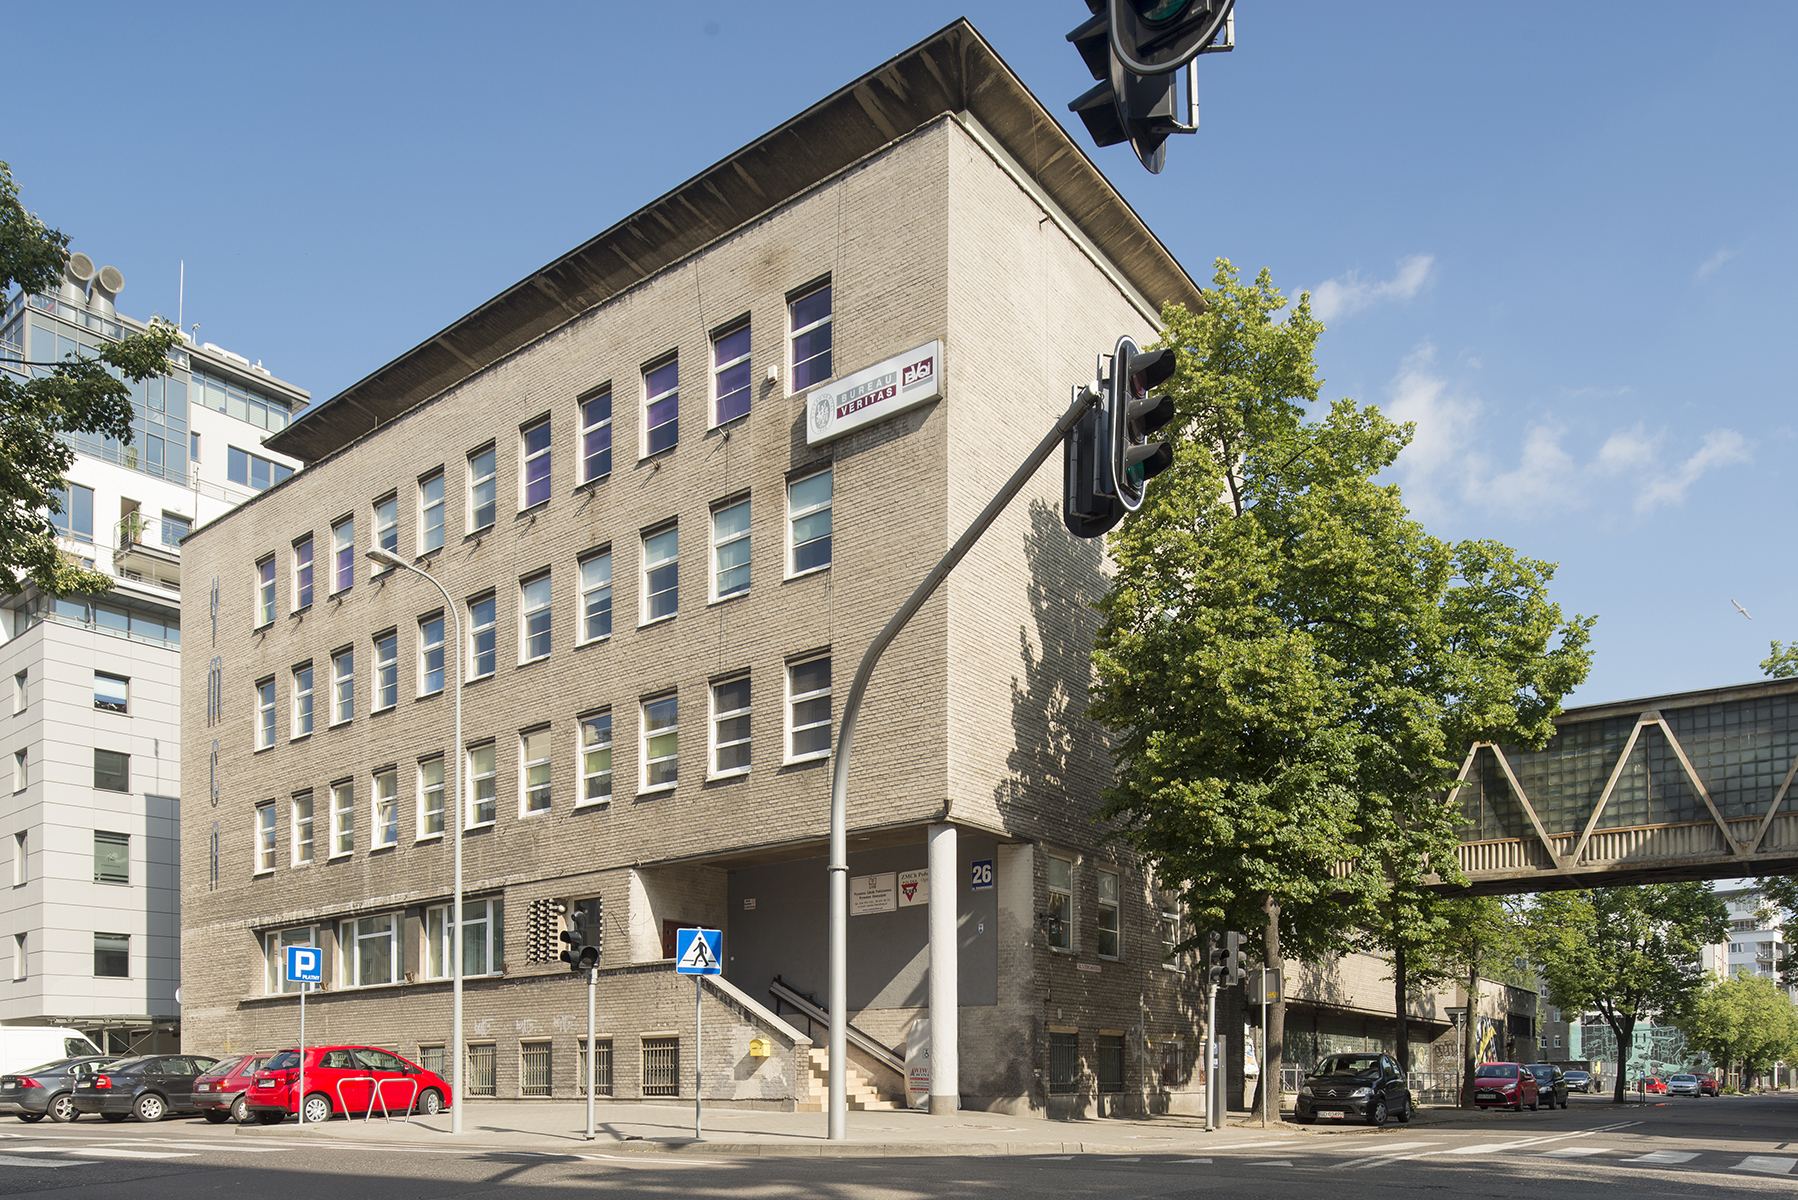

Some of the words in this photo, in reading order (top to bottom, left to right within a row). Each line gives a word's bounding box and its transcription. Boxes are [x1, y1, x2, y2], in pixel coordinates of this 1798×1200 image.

[842, 375, 892, 402] BUREAU
[842, 388, 893, 415] VERITAS
[972, 864, 992, 884] 26
[296, 951, 315, 977] P
